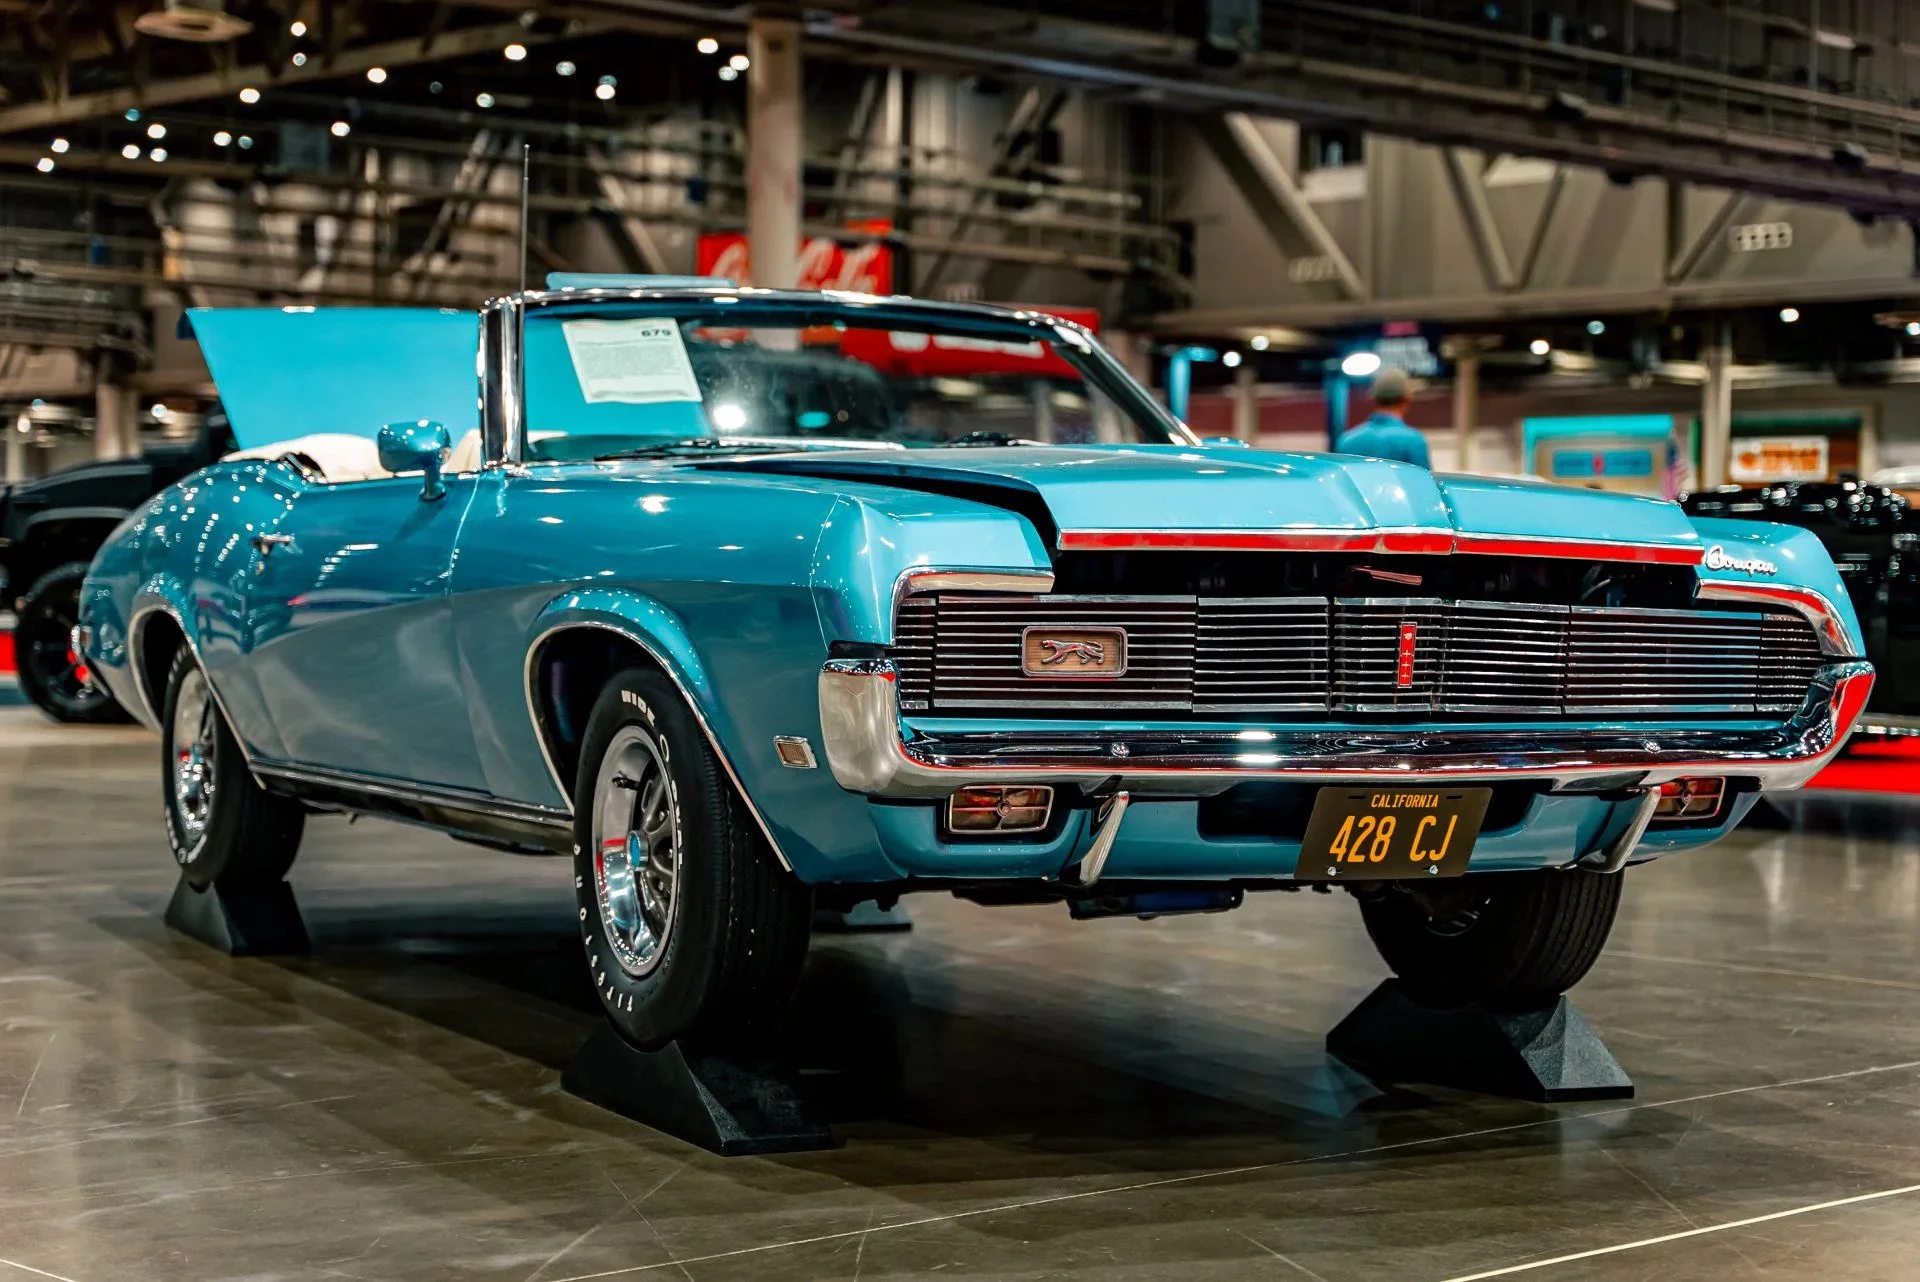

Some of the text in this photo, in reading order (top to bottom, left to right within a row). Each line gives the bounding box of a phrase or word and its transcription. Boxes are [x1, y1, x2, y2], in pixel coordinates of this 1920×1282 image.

[1706, 544, 1778, 577] Cougar
[621, 690, 656, 726] WIDE
[1371, 794, 1439, 808] CALIFORNIA
[1329, 814, 1458, 863] 428 CJ
